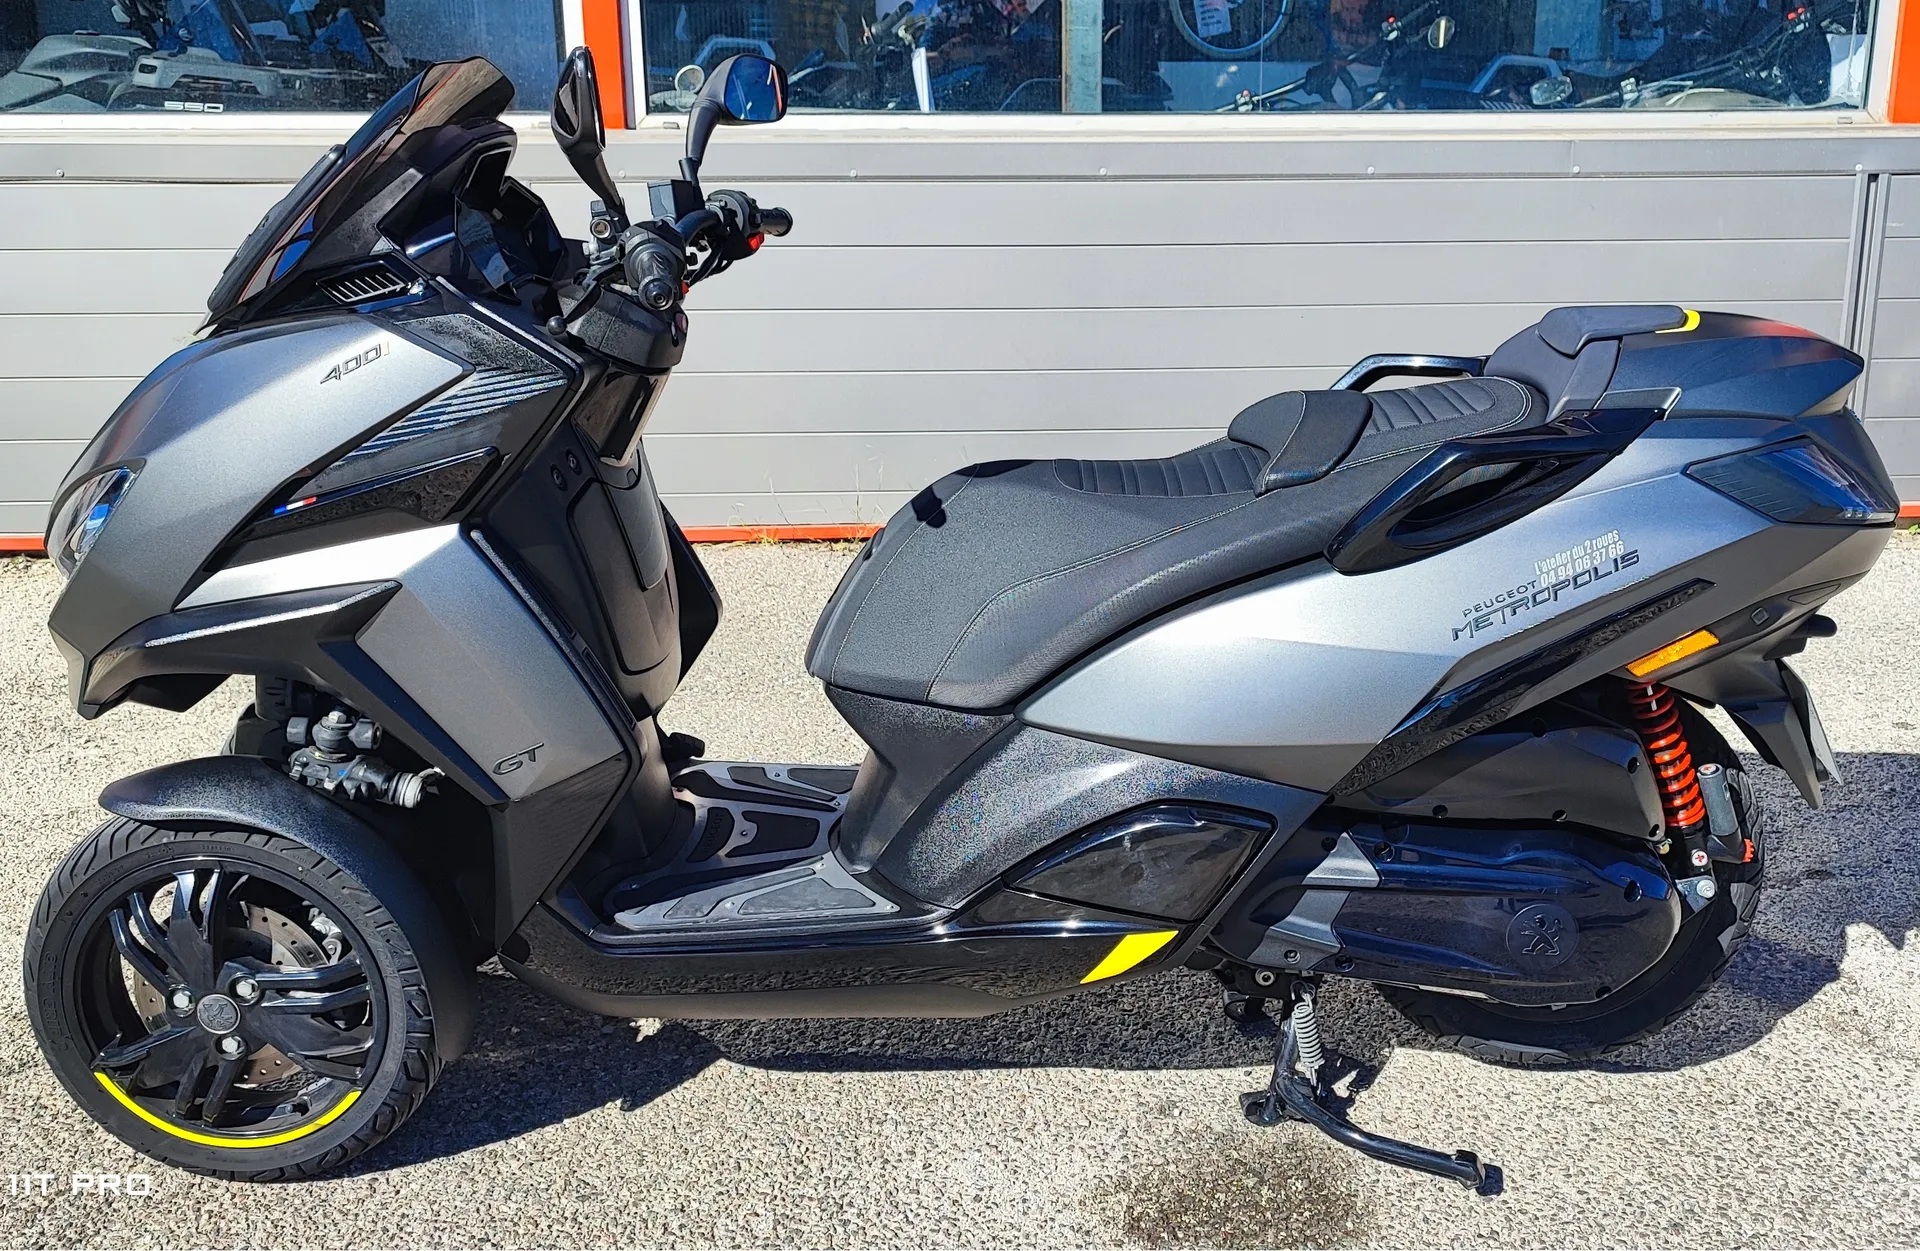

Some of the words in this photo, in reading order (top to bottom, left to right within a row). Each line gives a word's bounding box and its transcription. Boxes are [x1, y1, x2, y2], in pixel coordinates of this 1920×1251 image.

[1534, 549, 1571, 576] L'atelier
[1572, 545, 1585, 559] du
[1584, 539, 1593, 555] 2
[1592, 529, 1619, 550] roues
[1540, 570, 1557, 588] 04
[1557, 562, 1574, 579] 94
[1575, 554, 1592, 571] 06
[1592, 545, 1607, 566] 37
[1608, 540, 1625, 559] 66
[1451, 549, 1640, 642] METROPOLIS
[1461, 579, 1537, 618] PEUGEOT
[492, 742, 545, 776] GT
